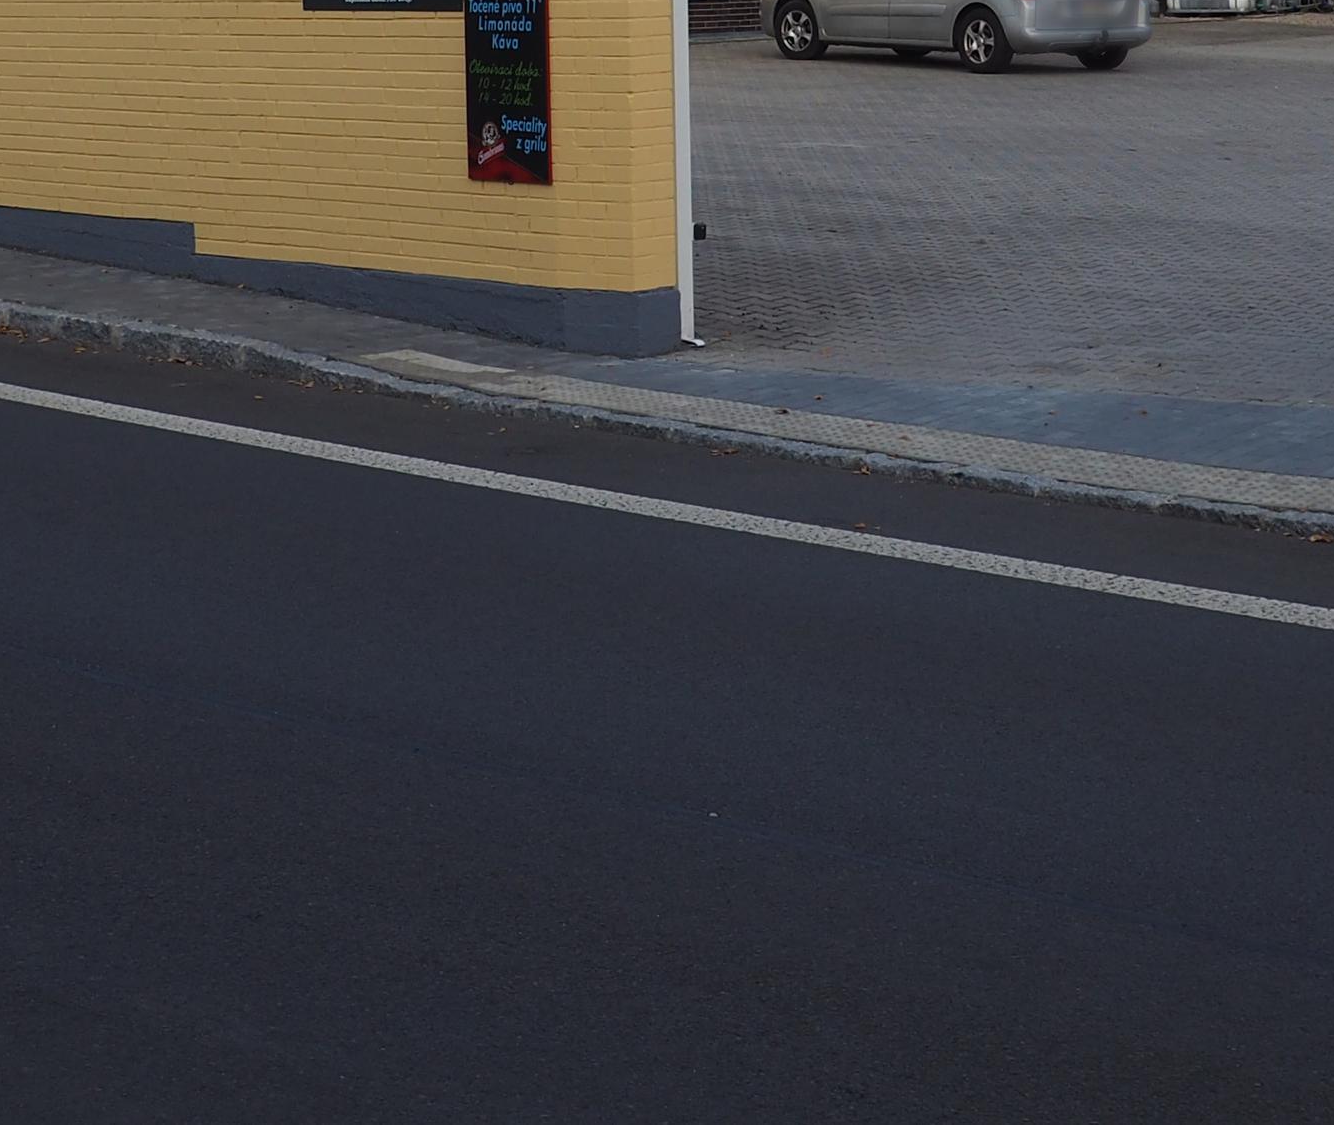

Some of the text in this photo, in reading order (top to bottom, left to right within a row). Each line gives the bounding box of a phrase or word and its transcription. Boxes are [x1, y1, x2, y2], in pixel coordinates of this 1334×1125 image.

[478, 15, 532, 32] Limonáda
[492, 33, 519, 50] Káva
[501, 115, 547, 137] Speciality
[516, 136, 547, 154] z grilu
